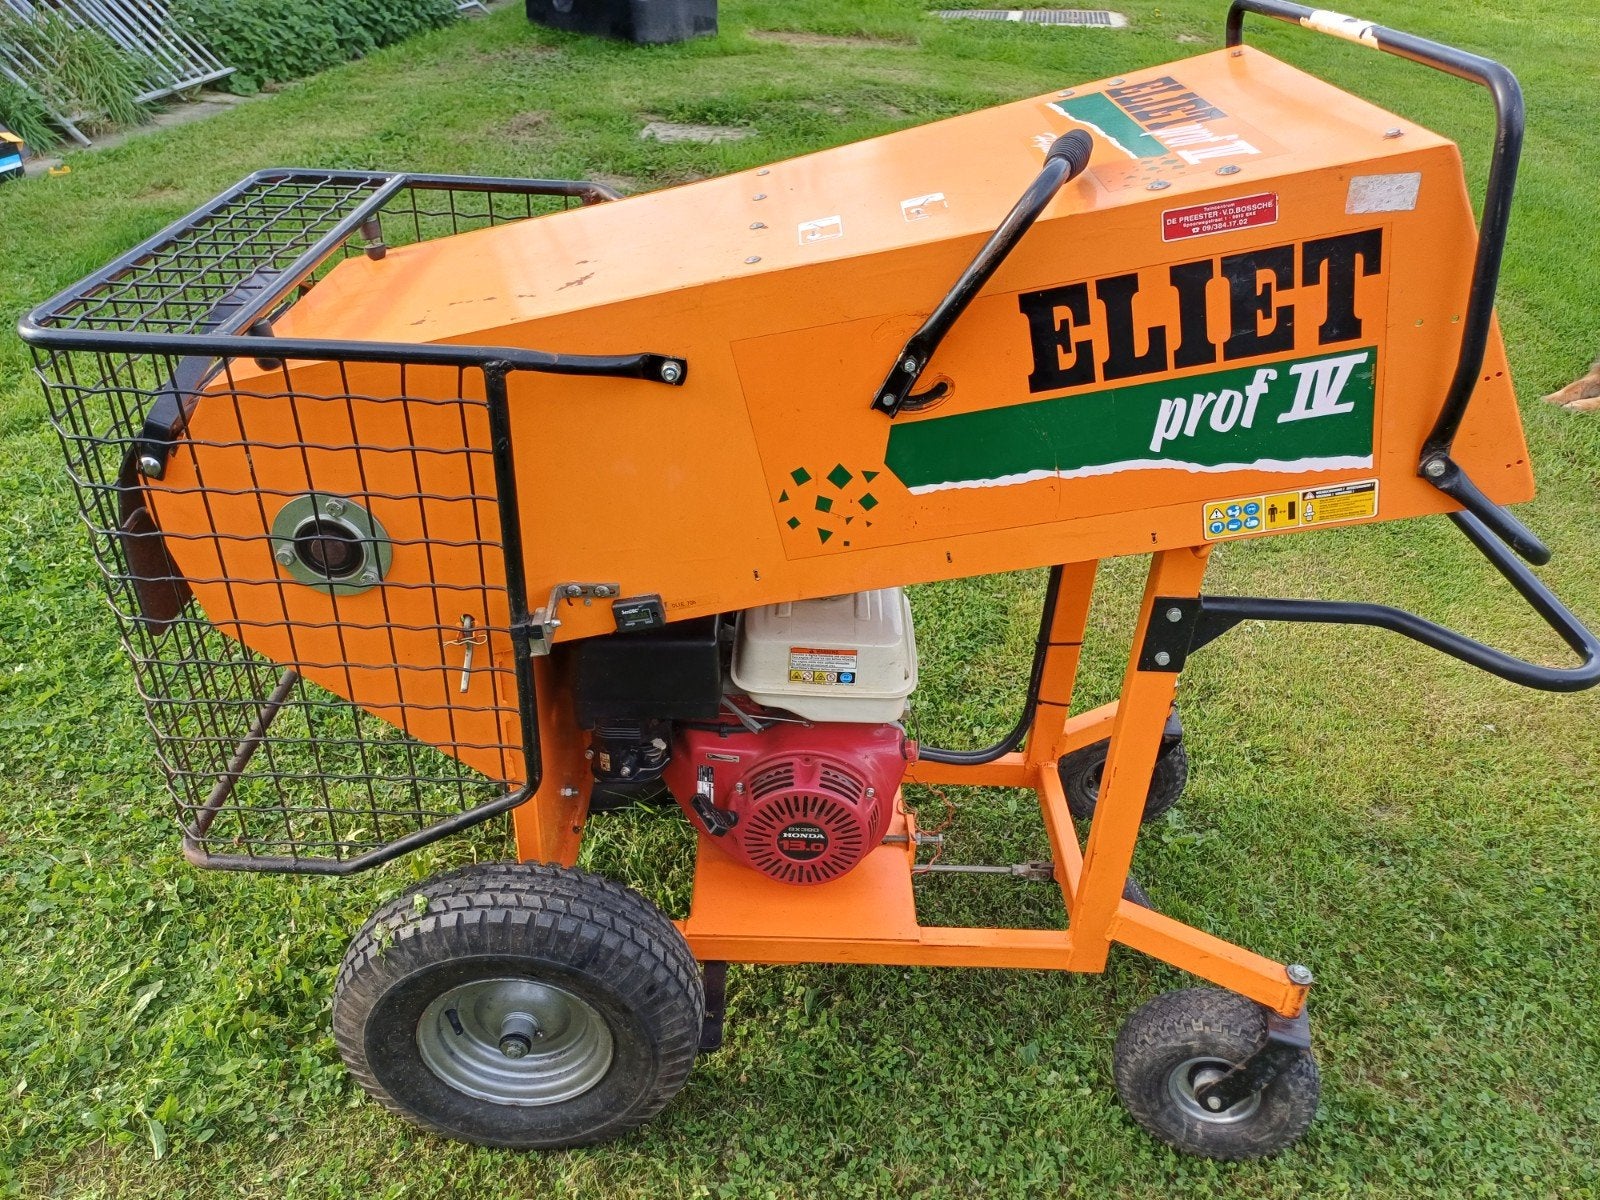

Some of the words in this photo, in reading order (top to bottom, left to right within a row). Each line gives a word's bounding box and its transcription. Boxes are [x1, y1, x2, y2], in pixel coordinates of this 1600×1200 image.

[1105, 76, 1228, 131] ELIET
[1166, 217, 1177, 226] DE
[1178, 209, 1219, 223] PREESTER
[1202, 218, 1248, 232] 09/384.17.02
[1018, 227, 1383, 394] ELIET
[1149, 367, 1278, 453] prof
[1276, 351, 1369, 424] IV
[779, 840, 825, 852] 13.0
